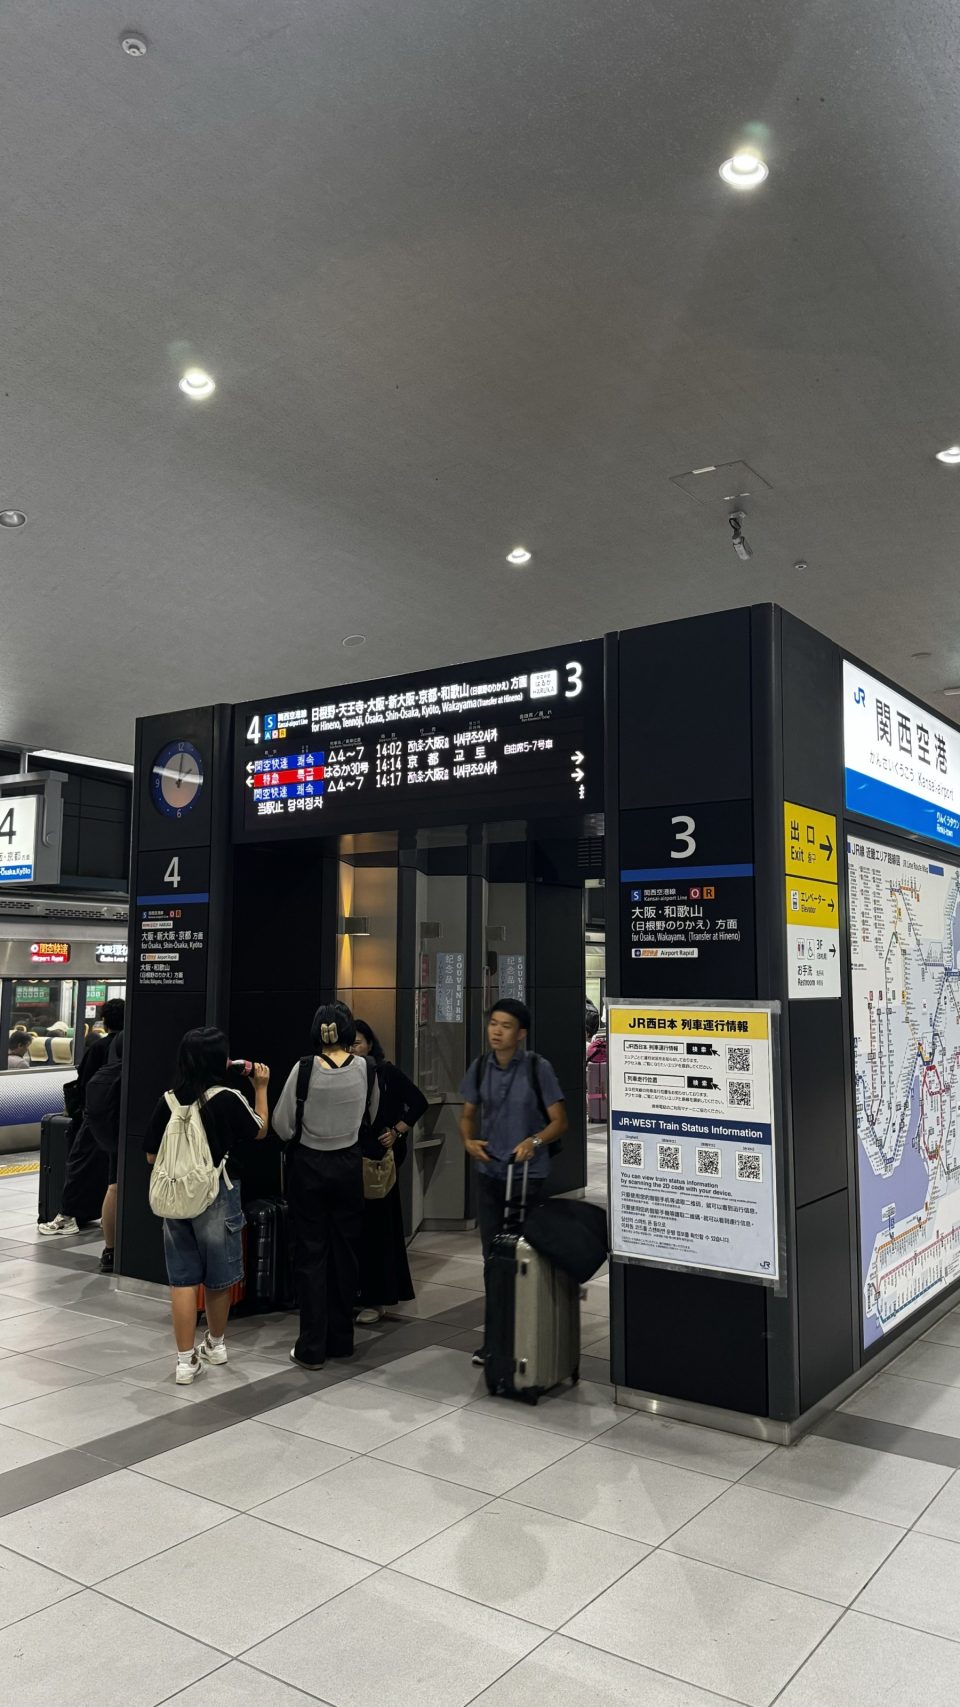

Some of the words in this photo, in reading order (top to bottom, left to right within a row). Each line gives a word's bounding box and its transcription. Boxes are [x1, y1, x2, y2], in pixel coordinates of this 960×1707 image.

[511, 675, 528, 690] 方面
[565, 661, 582, 697] 3
[854, 687, 865, 707] JR
[268, 717, 273, 727] S
[320, 720, 341, 731] Hineno,
[386, 709, 421, 722] Shin-Ōsaka,
[442, 700, 476, 713] Wakayama
[247, 716, 261, 744] 4
[876, 698, 948, 775] 関西空港
[178, 742, 184, 751] 12
[376, 742, 402, 757] 14:02
[263, 772, 279, 786] 特急
[297, 768, 314, 782] 특급
[376, 758, 402, 773] 14:14
[156, 779, 160, 788] 9
[376, 772, 402, 788] 14:17
[258, 801, 284, 815] 当駅止
[288, 796, 323, 812] 당역정차
[177, 809, 182, 818] 6
[0, 808, 16, 844] 4
[791, 820, 815, 844] 出口
[670, 816, 696, 859] 3
[791, 846, 804, 862] Exit
[852, 843, 864, 857] JR線
[164, 857, 180, 888] 4
[634, 891, 639, 901] S
[644, 888, 676, 896] 関西空港線
[692, 889, 699, 898] O
[707, 889, 712, 897] R
[801, 892, 826, 904] エレベーター
[632, 905, 703, 919] 大阪・和歌山
[631, 920, 710, 931] （日根野のりかえ）
[716, 919, 738, 930] 方面
[640, 931, 656, 942] Ōsaka,
[657, 932, 687, 943] Wakayama,
[689, 931, 712, 942] (Transfer
[713, 932, 718, 940] at
[719, 931, 740, 941] Hineno)
[817, 940, 823, 950] 3F
[798, 978, 815, 987] Restroom
[629, 1018, 677, 1030] JR西日本
[681, 1019, 748, 1032] 列車運行情報
[649, 1044, 678, 1052] 列車運行情報
[627, 1076, 658, 1084] 列車走行位置
[619, 1118, 656, 1128] JR-WEST
[658, 1121, 679, 1130] Train
[682, 1123, 709, 1133] Status
[711, 1126, 762, 1138] Information
[628, 1180, 652, 1188] scanning
[713, 1189, 732, 1197] device.
[686, 1179, 718, 1188] information
